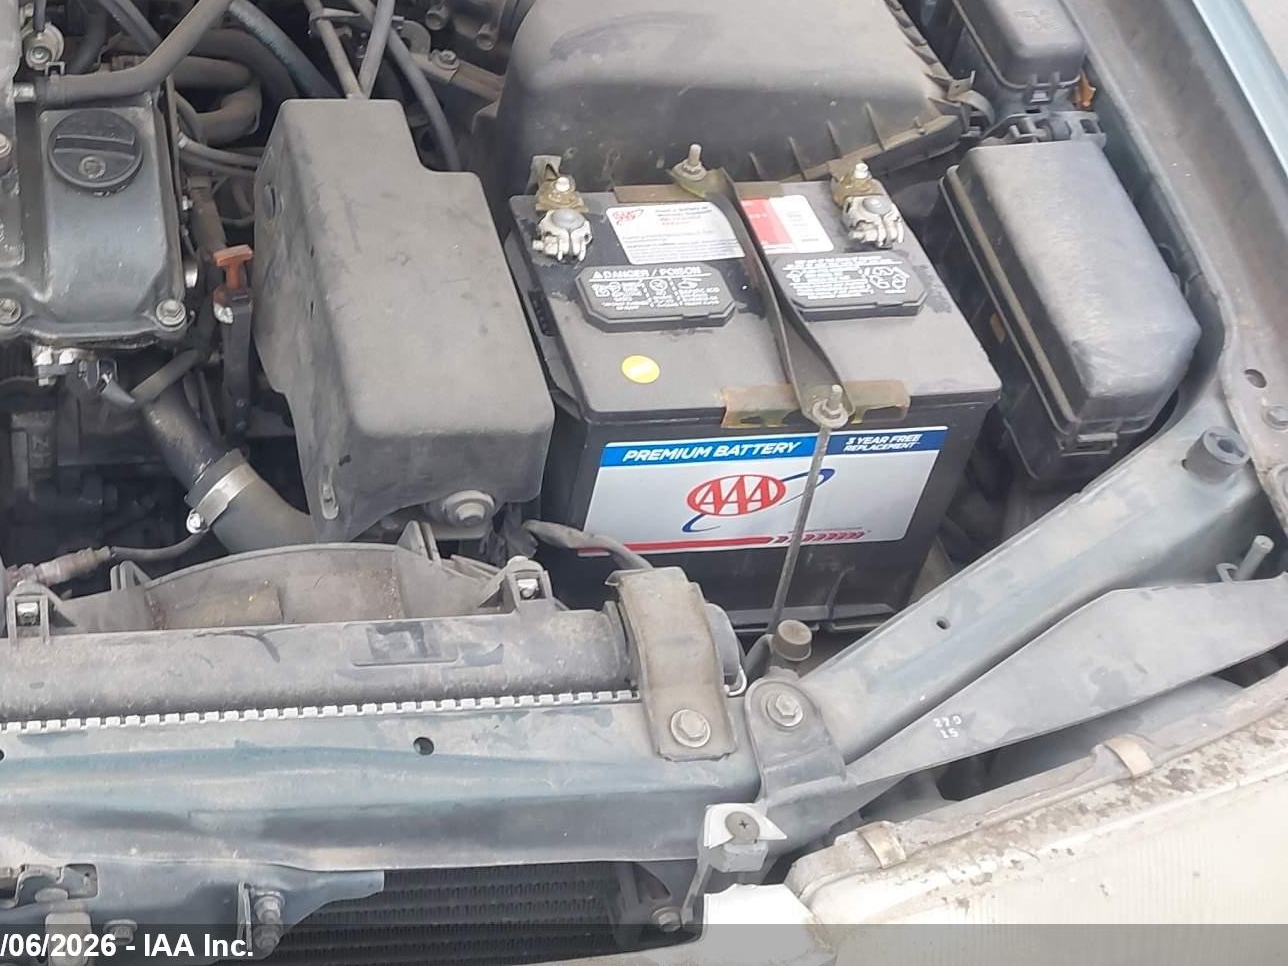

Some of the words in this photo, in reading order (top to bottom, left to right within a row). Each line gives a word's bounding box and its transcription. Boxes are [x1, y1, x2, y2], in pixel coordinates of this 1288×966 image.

[846, 437, 856, 445] 3
[857, 436, 890, 445] YEAR
[889, 433, 923, 443] FREE
[622, 446, 711, 463] PREMIUM
[713, 441, 802, 458] BATTERY
[695, 475, 778, 515] AAA
